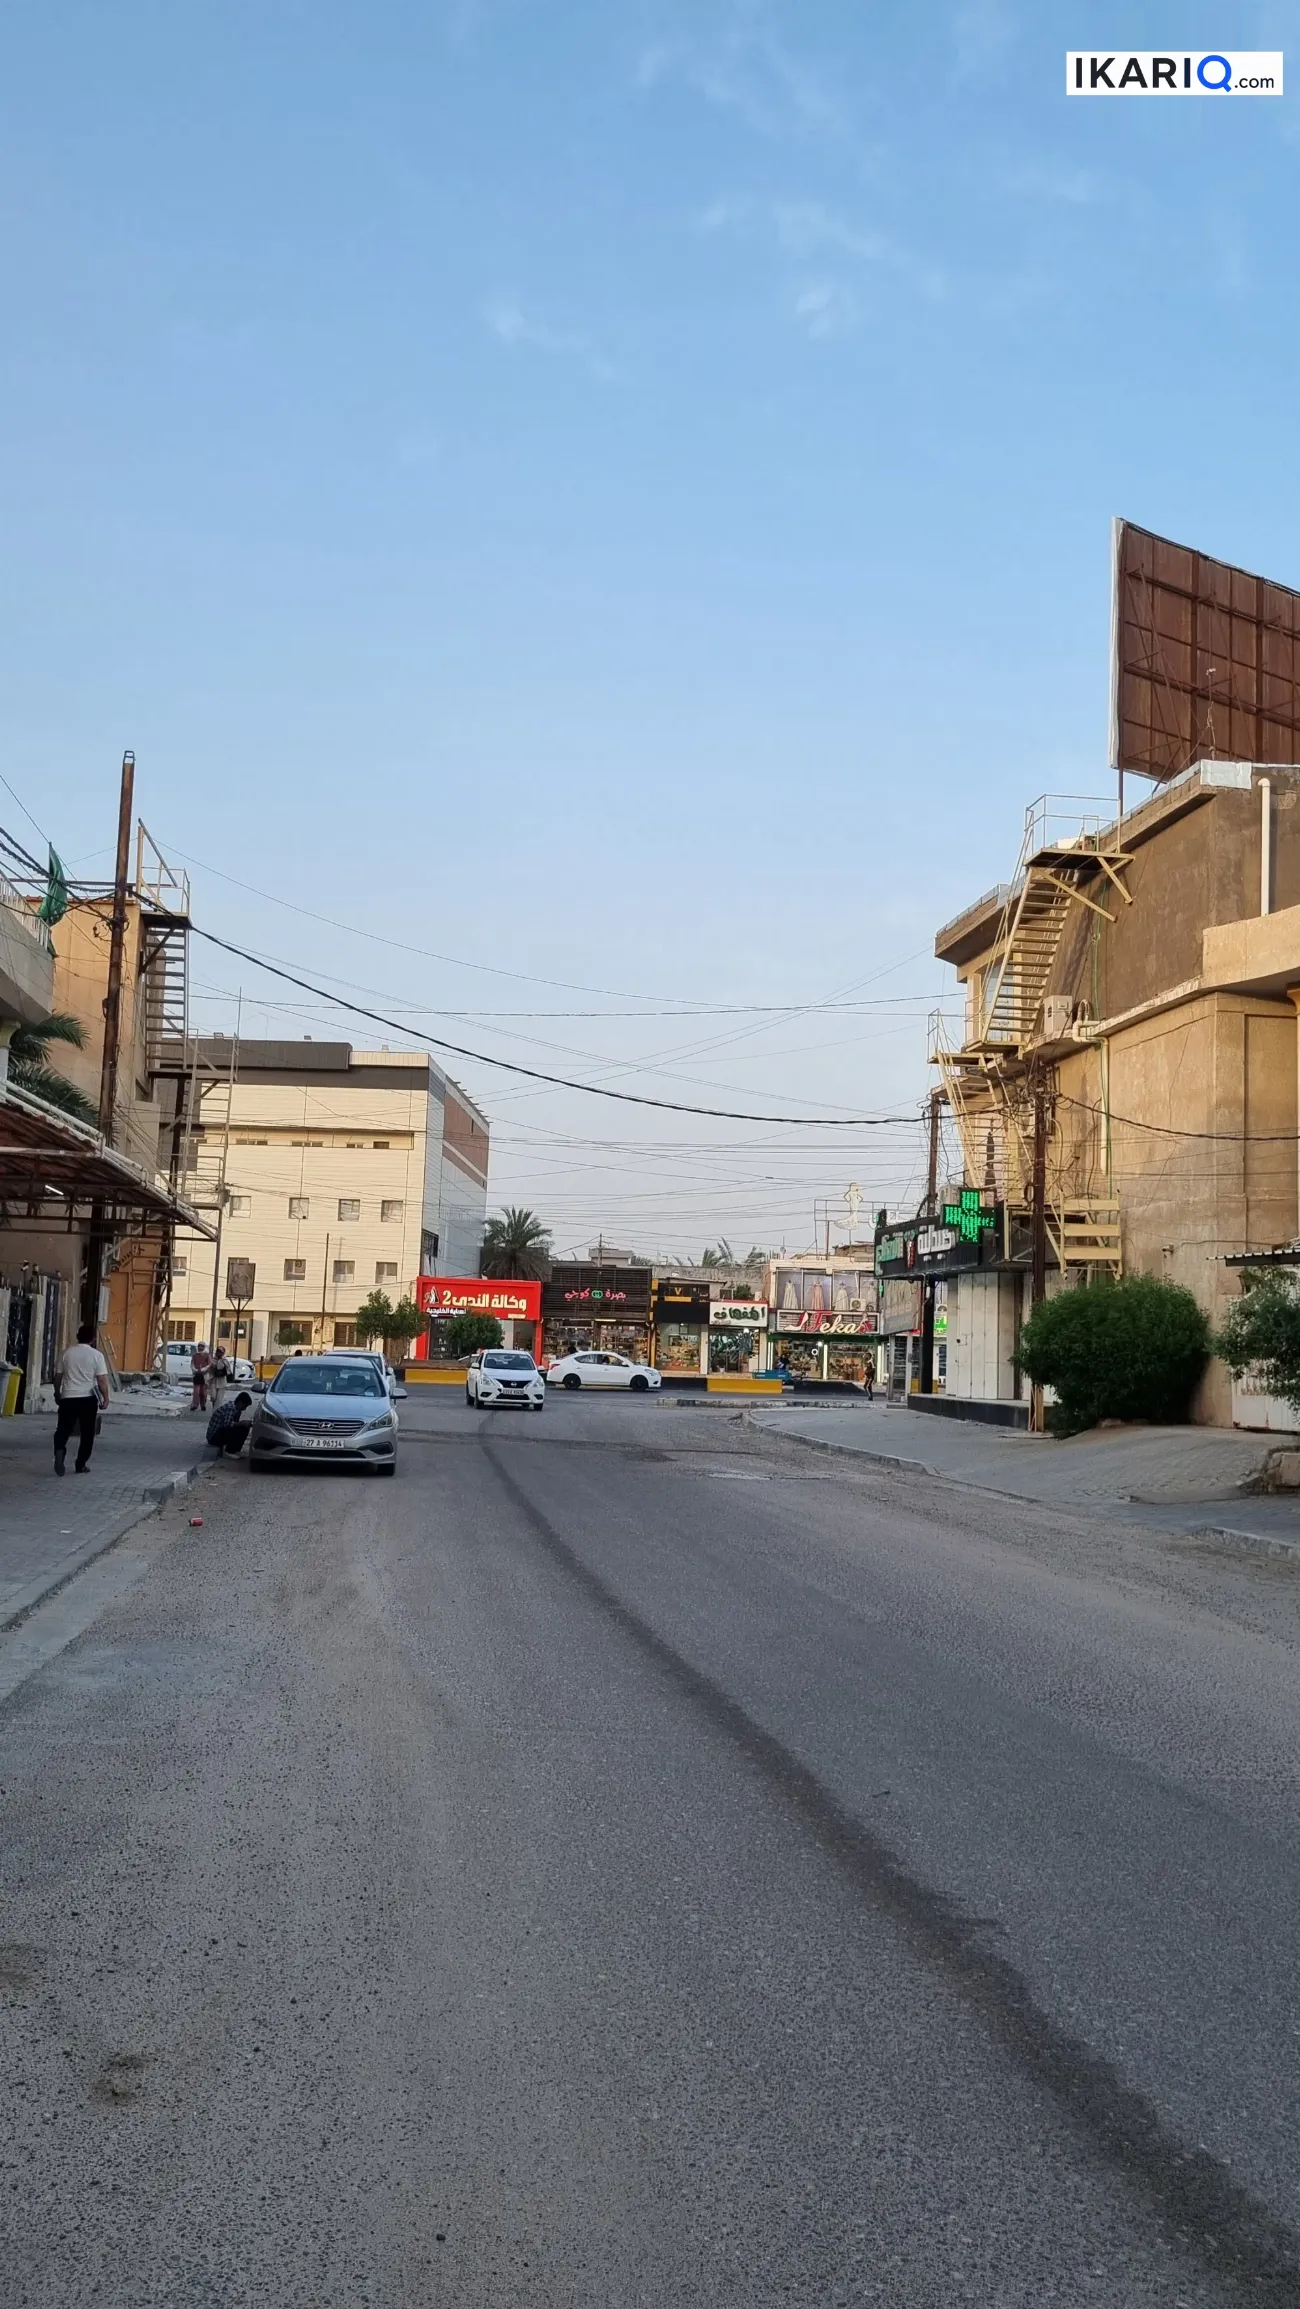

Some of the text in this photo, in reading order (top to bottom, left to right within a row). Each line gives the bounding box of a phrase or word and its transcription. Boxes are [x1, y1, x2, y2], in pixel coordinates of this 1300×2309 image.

[442, 1290, 527, 1311] وكالة الندى 2
[605, 1288, 627, 1302] بصرة
